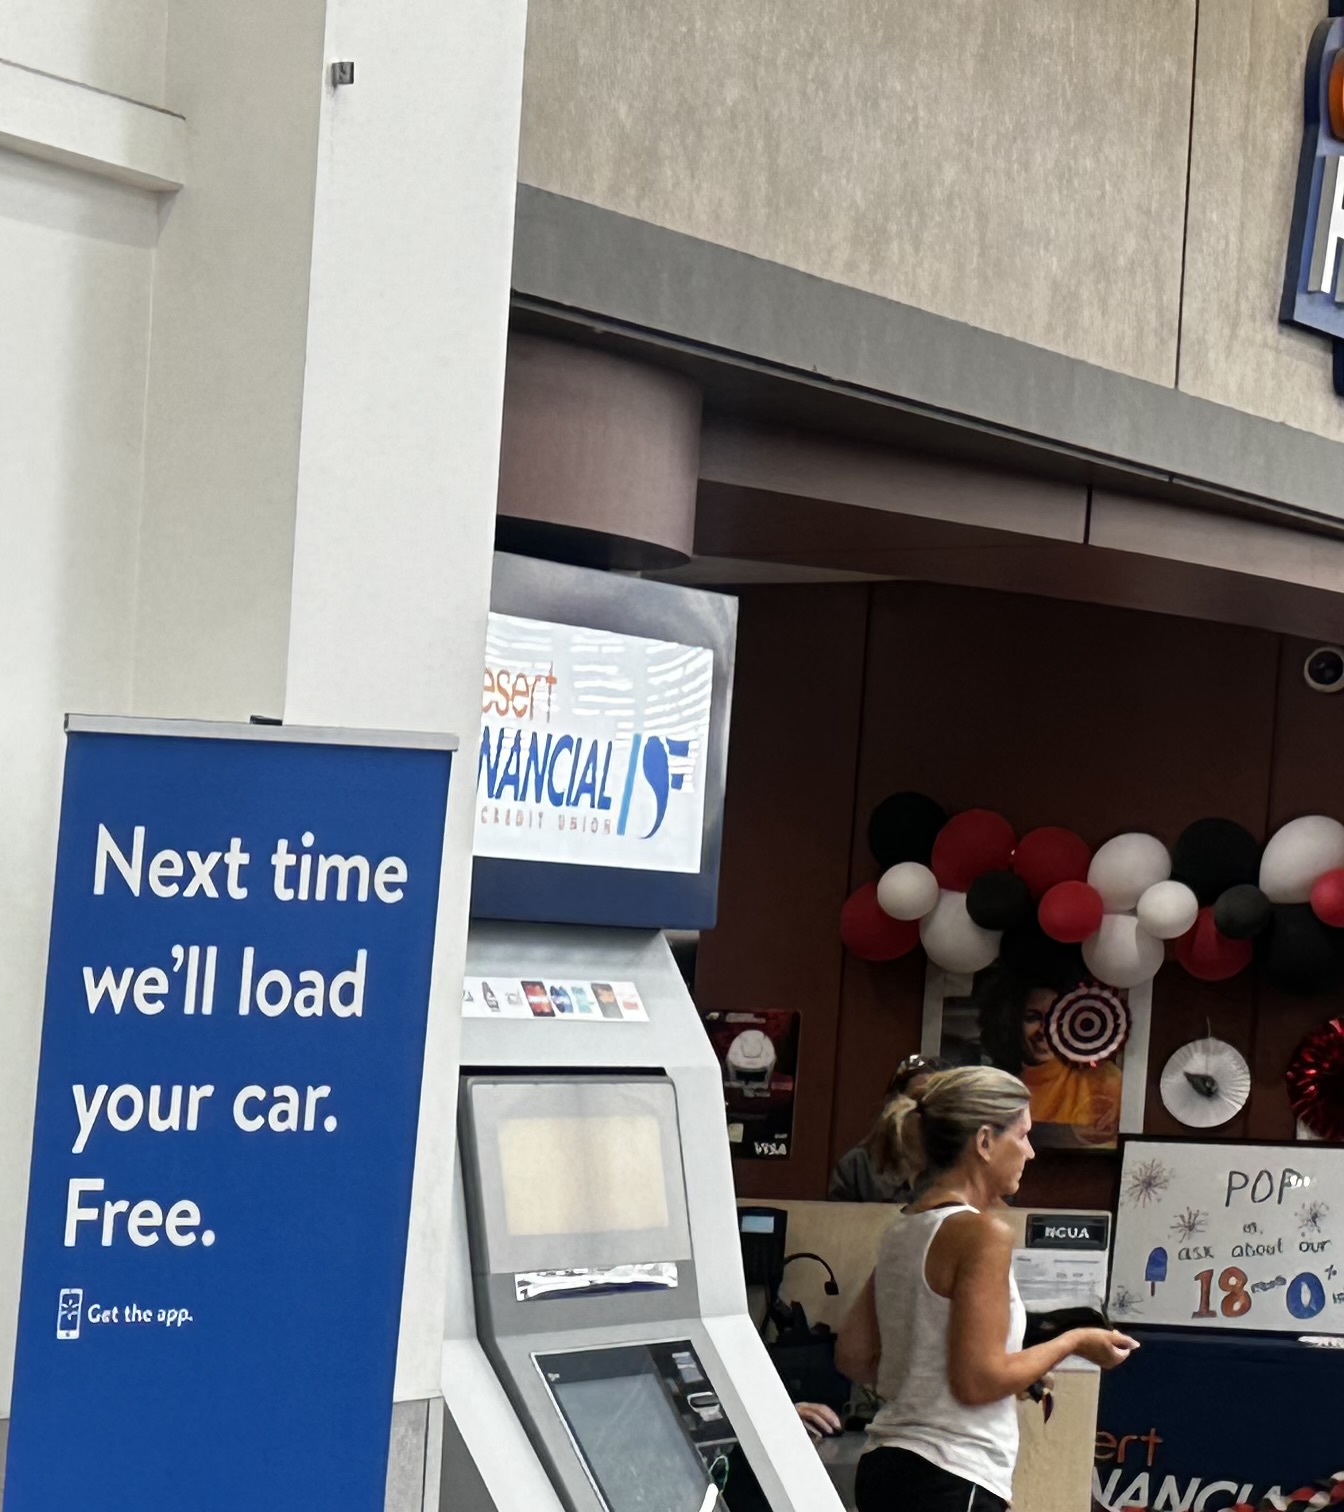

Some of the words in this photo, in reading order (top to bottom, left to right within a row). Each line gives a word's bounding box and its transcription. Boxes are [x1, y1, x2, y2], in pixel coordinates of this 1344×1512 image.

[481, 661, 557, 723] esert
[558, 813, 612, 835] UNION
[93, 823, 250, 899] Next
[271, 831, 408, 903] time
[82, 944, 218, 1016] we'll
[239, 947, 368, 1018] load
[71, 1082, 215, 1155] your
[232, 1082, 338, 1133] car.
[1224, 1168, 1303, 1208] POP
[63, 1177, 216, 1249] Free.
[1044, 1226, 1090, 1239] NCUA
[1231, 1237, 1284, 1259] about
[1298, 1238, 1333, 1253] our
[87, 1303, 119, 1324] Get
[124, 1303, 153, 1323] the
[156, 1308, 194, 1328] app.
[1191, 1265, 1253, 1319] 18
[1094, 1427, 1164, 1467] ert
